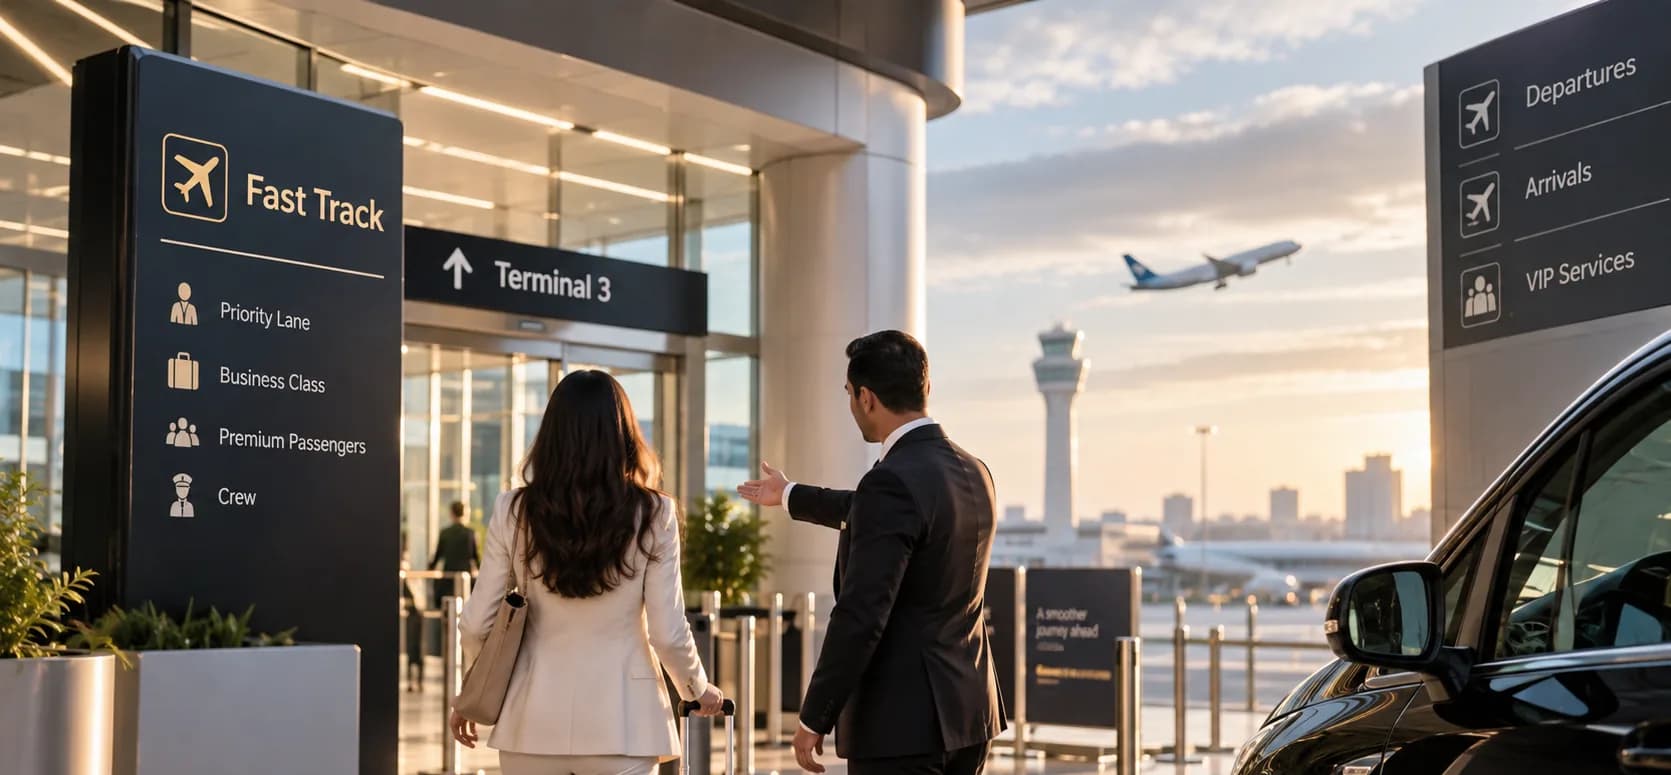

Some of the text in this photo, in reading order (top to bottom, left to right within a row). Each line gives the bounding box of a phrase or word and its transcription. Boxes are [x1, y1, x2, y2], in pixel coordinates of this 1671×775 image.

[1526, 57, 1637, 108] Departures
[1525, 161, 1593, 200] Arrivals
[247, 173, 385, 232] Fast Track
[494, 260, 612, 303] Terminal 3
[1525, 251, 1635, 292] VIP Services
[220, 301, 311, 331] Priority Lane
[220, 365, 326, 394] Business Class
[219, 427, 367, 457] Premium Passengers
[218, 487, 257, 506] Crew
[1036, 607, 1088, 621] A smoother
[1035, 624, 1099, 640] journey ahead
